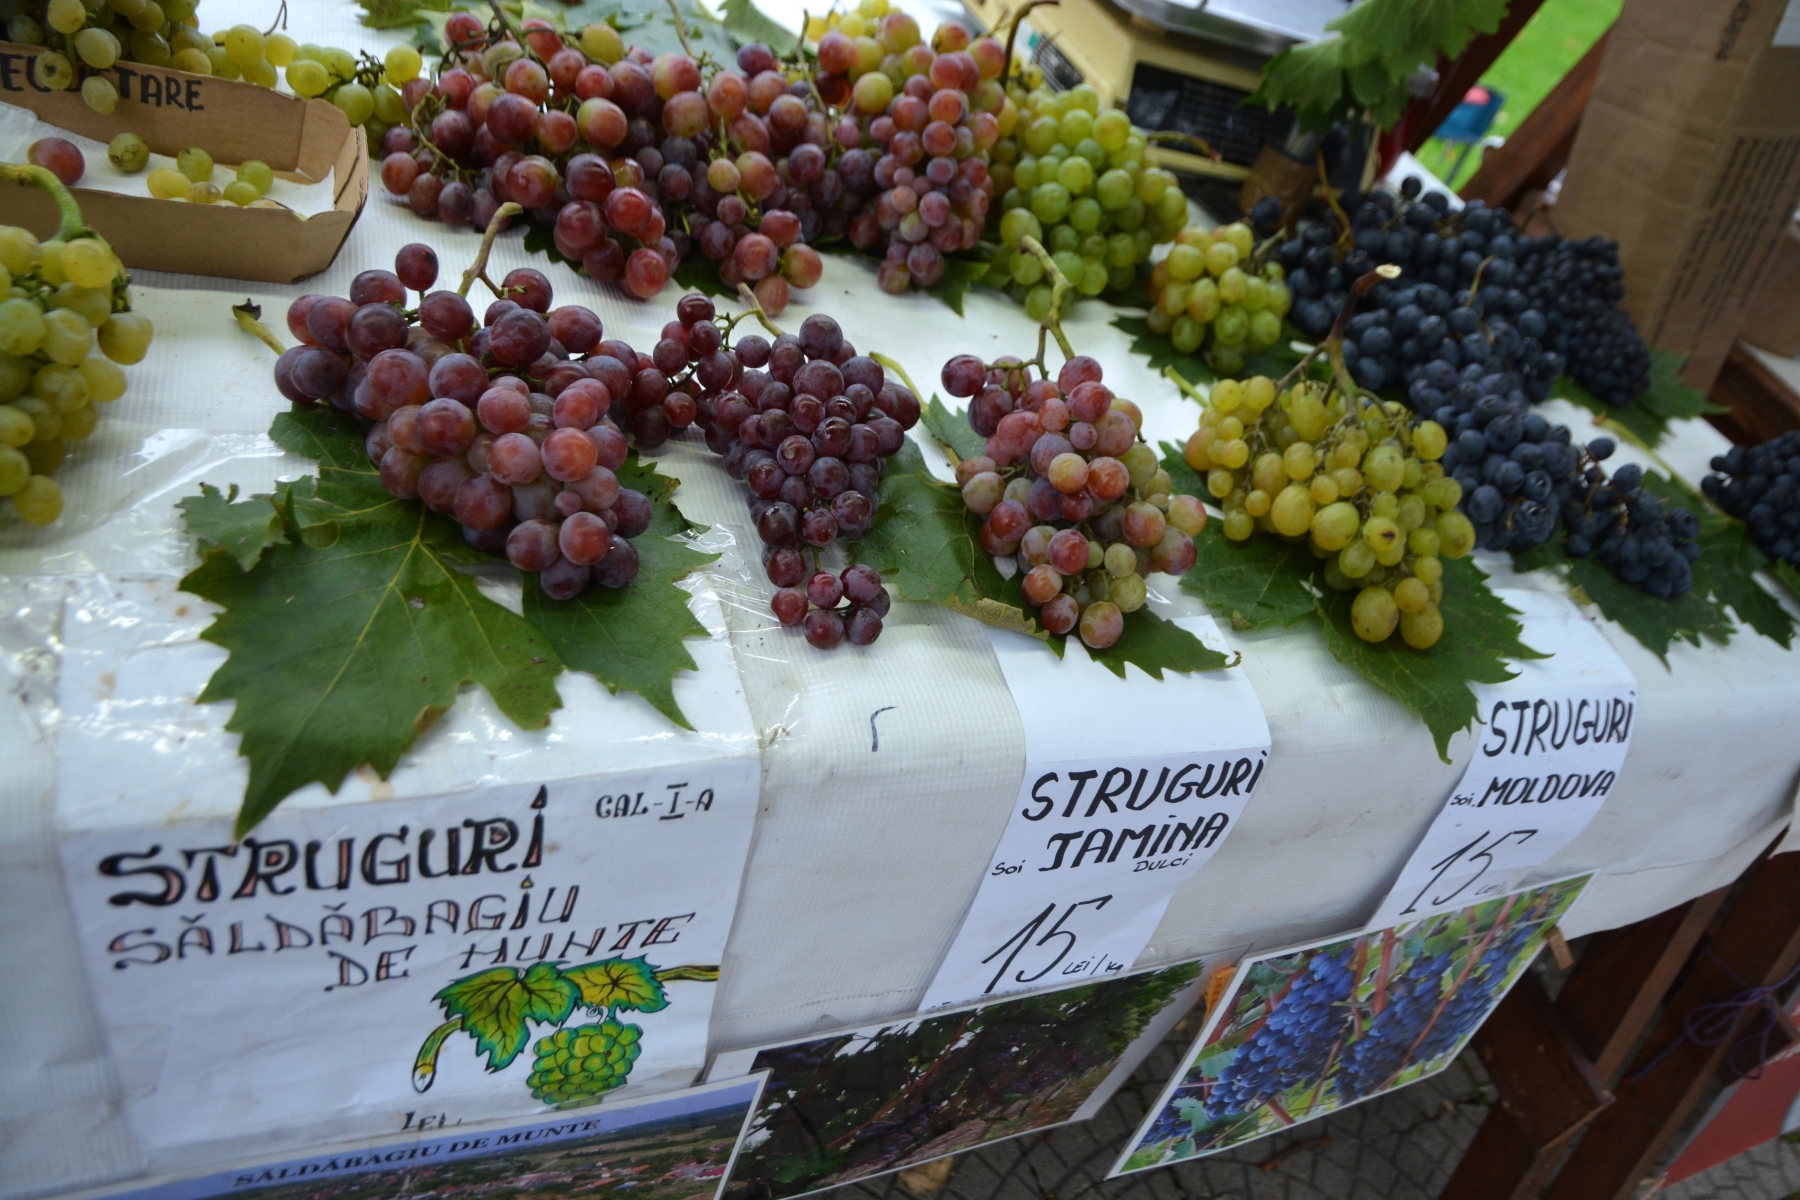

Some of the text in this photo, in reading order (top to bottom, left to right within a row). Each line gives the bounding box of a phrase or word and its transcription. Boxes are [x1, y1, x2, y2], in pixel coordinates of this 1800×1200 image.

[1483, 690, 1636, 757] STRUGURI
[1022, 750, 1268, 821] STRUGURI
[1477, 770, 1617, 807] MOLDOVA
[99, 785, 548, 907] STRUGURI
[1039, 812, 1229, 872] TAMINA
[1399, 829, 1538, 916] 15
[325, 945, 418, 991] DE
[981, 894, 1113, 993] 15
[449, 1137, 491, 1154] DE
[495, 1119, 602, 1147] MUNTE
